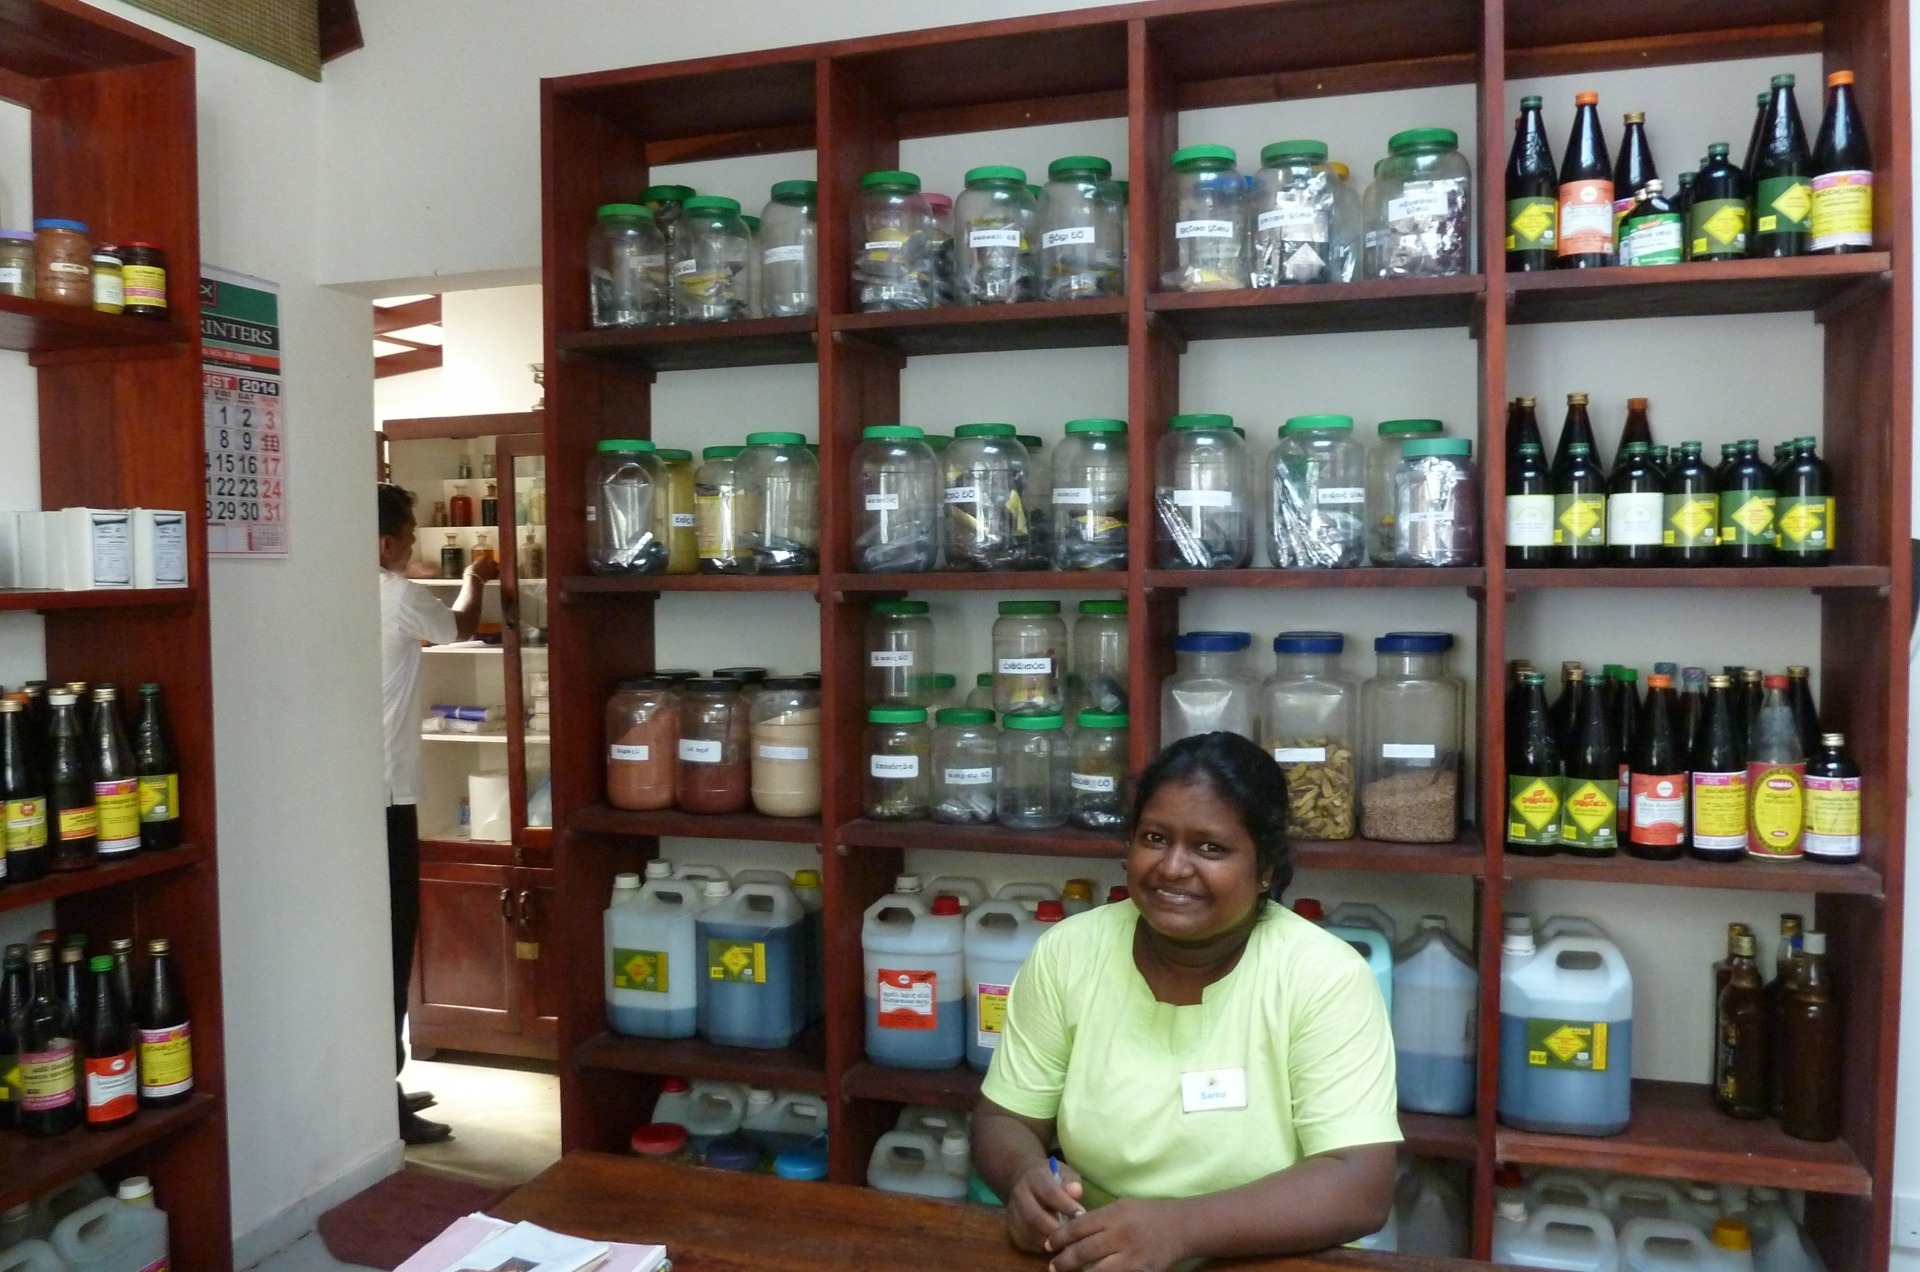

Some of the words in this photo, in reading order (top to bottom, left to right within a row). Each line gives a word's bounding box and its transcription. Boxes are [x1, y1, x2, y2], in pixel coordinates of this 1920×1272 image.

[242, 380, 277, 395] 2014
[220, 406, 228, 425] 1
[242, 408, 252, 428] 2
[265, 411, 276, 430] 3
[219, 429, 230, 449] 8
[242, 432, 253, 451] 9
[216, 453, 235, 473] 15
[238, 455, 258, 475] 16
[261, 457, 281, 477] 17
[216, 477, 236, 497] 22
[239, 479, 259, 498] 23
[262, 480, 282, 499] 24
[217, 501, 236, 521] 29
[240, 502, 260, 522] 30
[264, 503, 281, 522] 31
[1768, 780, 1794, 788] BIMAL
